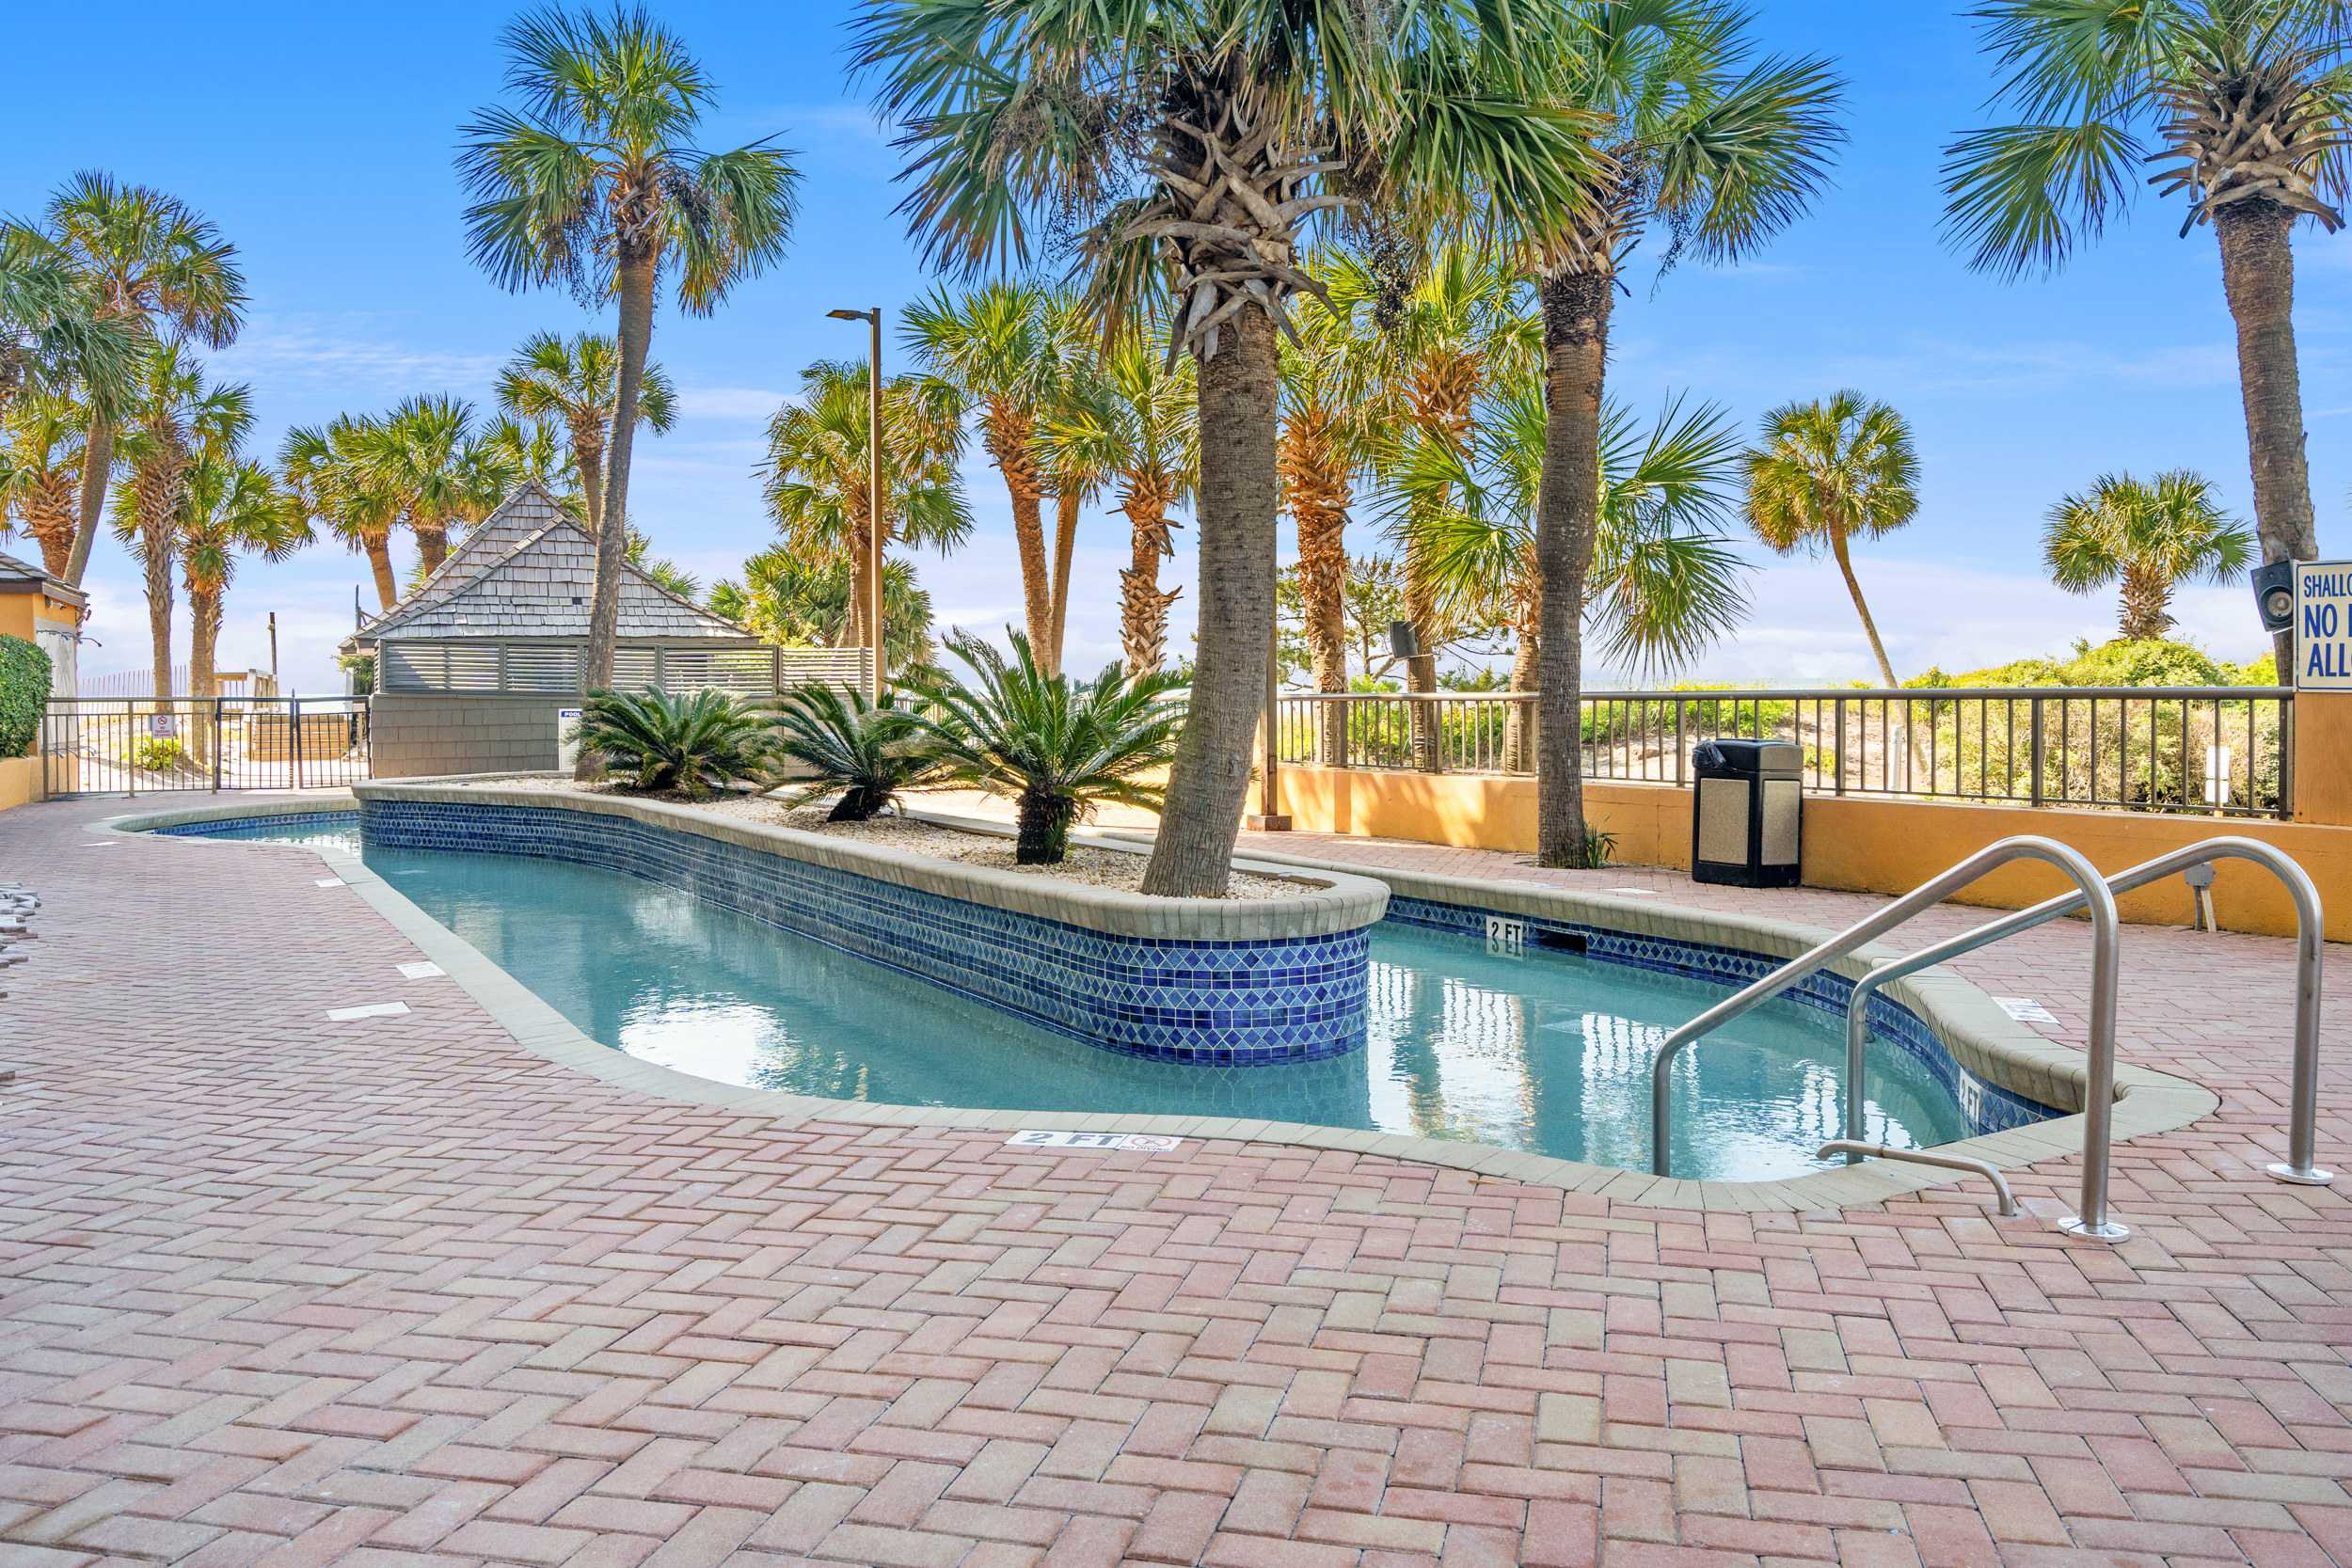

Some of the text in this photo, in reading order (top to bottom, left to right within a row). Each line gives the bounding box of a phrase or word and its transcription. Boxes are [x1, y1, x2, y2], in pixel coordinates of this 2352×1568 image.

[2305, 604, 2337, 638] NO
[2307, 643, 2352, 677] ALL
[1492, 921, 1520, 942] 2 FT
[1968, 1086, 1979, 1120] FT
[1023, 1132, 1123, 1146] 2 FT
